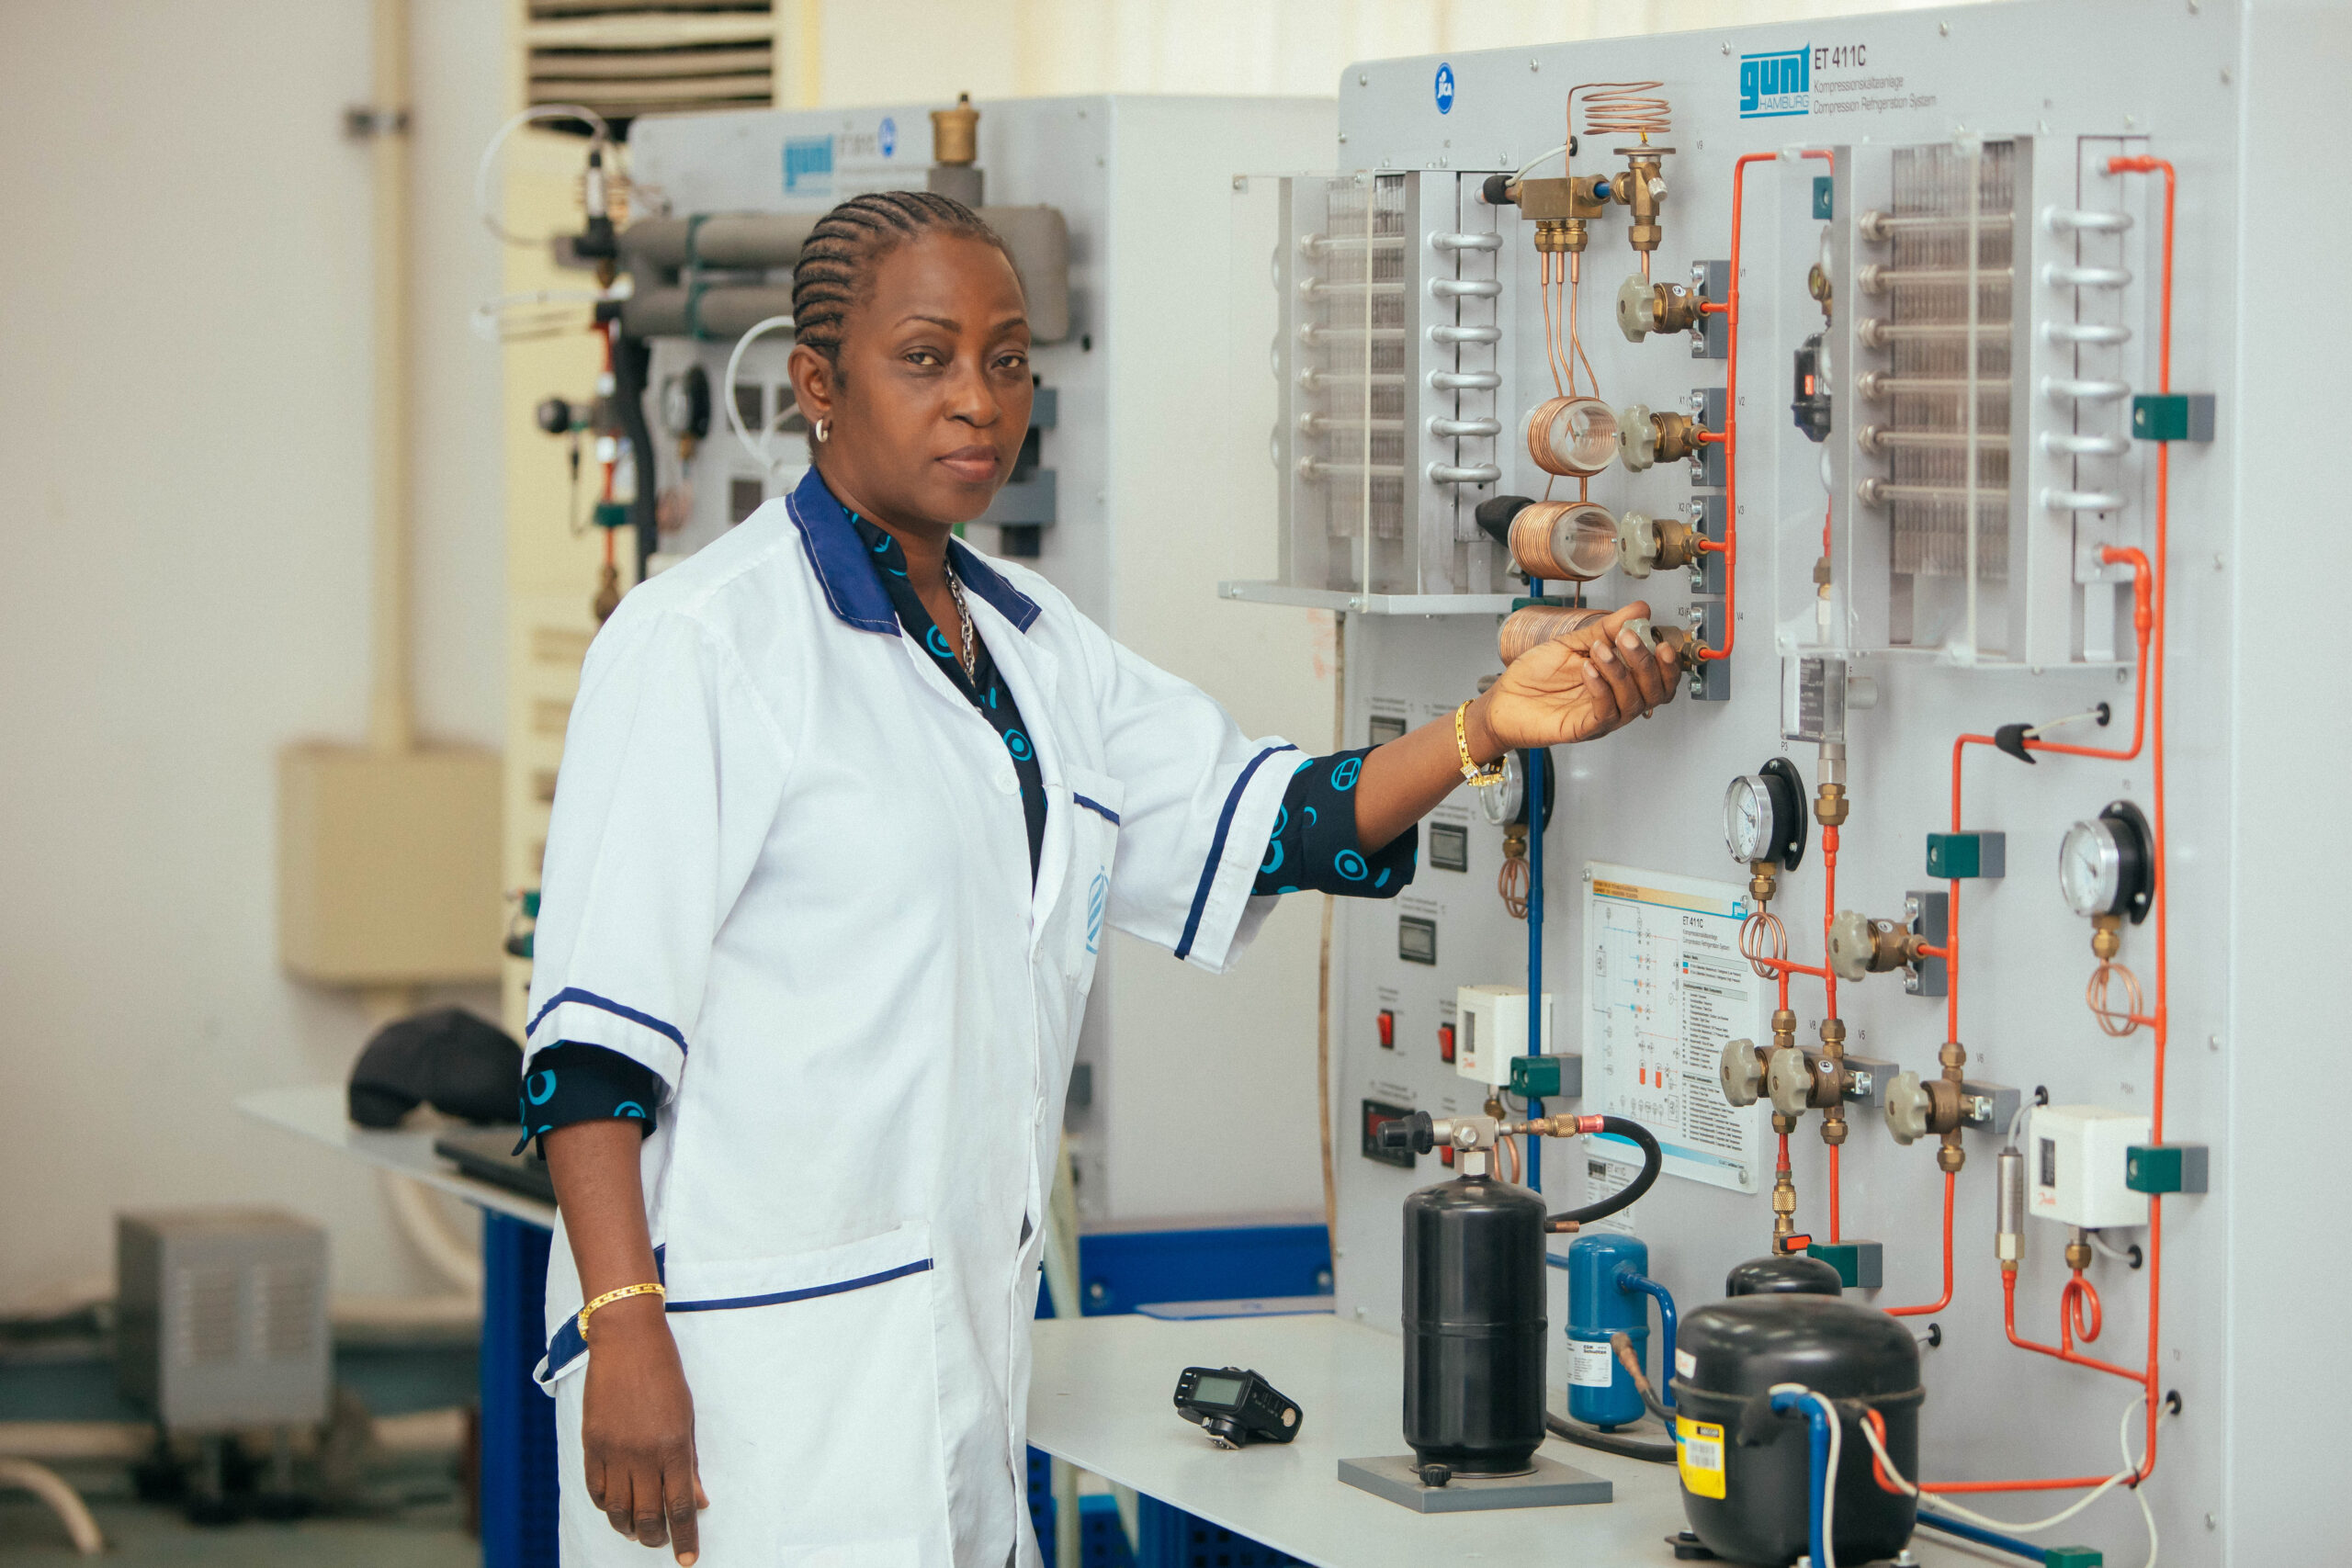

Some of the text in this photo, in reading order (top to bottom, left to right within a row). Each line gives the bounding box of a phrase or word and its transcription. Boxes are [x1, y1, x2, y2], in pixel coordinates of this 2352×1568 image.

[1815, 44, 1866, 70] ET 411C
[1740, 40, 1810, 112] gunt
[1759, 94, 1810, 111] HAMBURG
[1814, 93, 1937, 116] Compression Refrigeration System
[1738, 396, 1746, 406] V2
[1737, 505, 1745, 515] V3
[1736, 612, 1744, 621] V4
[1781, 741, 1789, 751] P3
[1690, 917, 1703, 929] 411C
[1809, 1020, 1816, 1030] V8
[1858, 1030, 1866, 1040] V5
